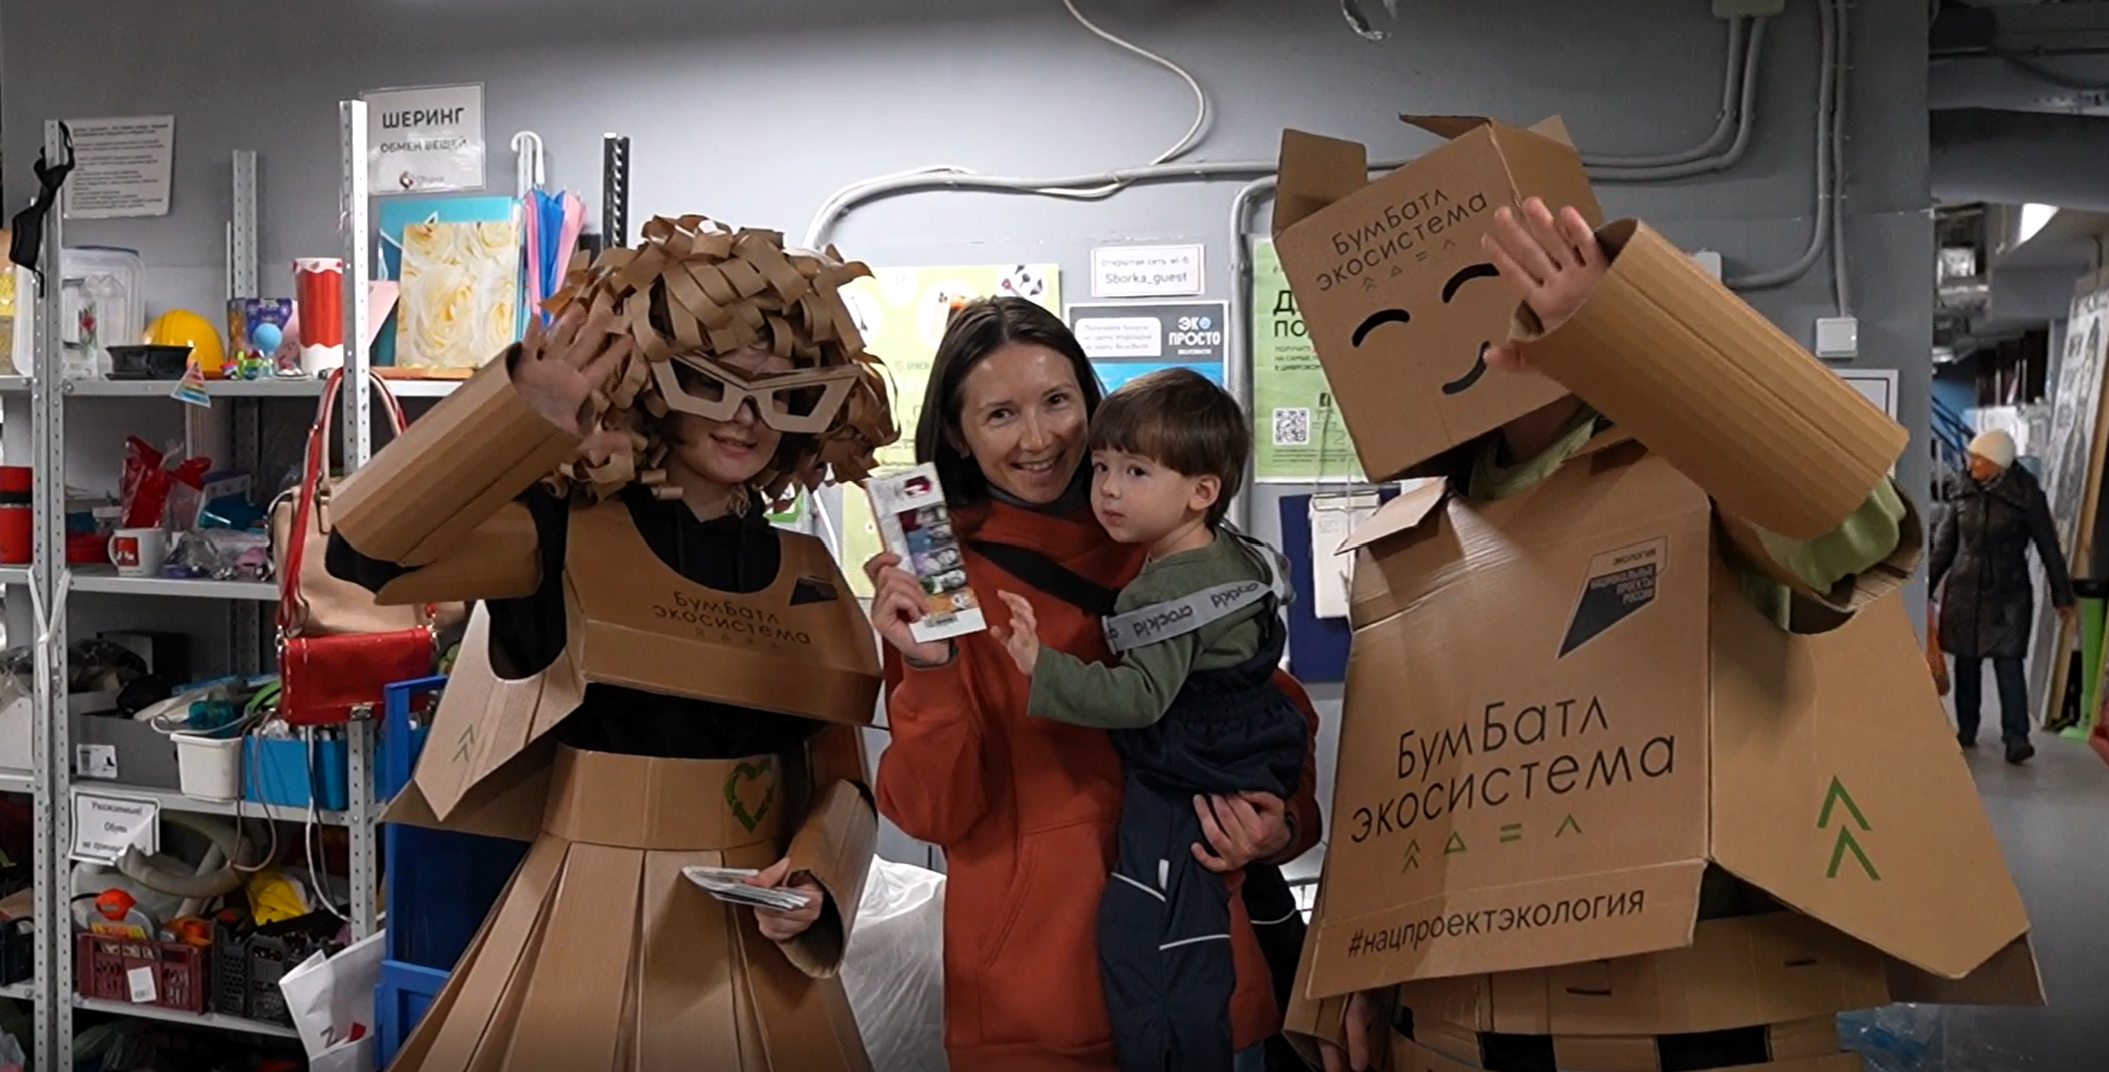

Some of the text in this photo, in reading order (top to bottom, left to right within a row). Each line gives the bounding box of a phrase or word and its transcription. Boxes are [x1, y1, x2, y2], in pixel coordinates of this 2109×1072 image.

[382, 107, 465, 129] ШЕРИНГ
[380, 140, 422, 154] ОБМЕН
[1315, 190, 1489, 292] экосистема
[1104, 271, 1187, 286] Sborka_guest
[1273, 289, 1295, 317] Д
[1168, 331, 1221, 347] ПРОСТО
[1274, 319, 1308, 338] ПО
[652, 604, 812, 645] экосистема
[1132, 604, 1194, 638] crockid
[1397, 695, 1609, 782] БумБатл
[1350, 734, 1676, 844] экосистема
[1347, 889, 1645, 958] #нацпроектэкология
